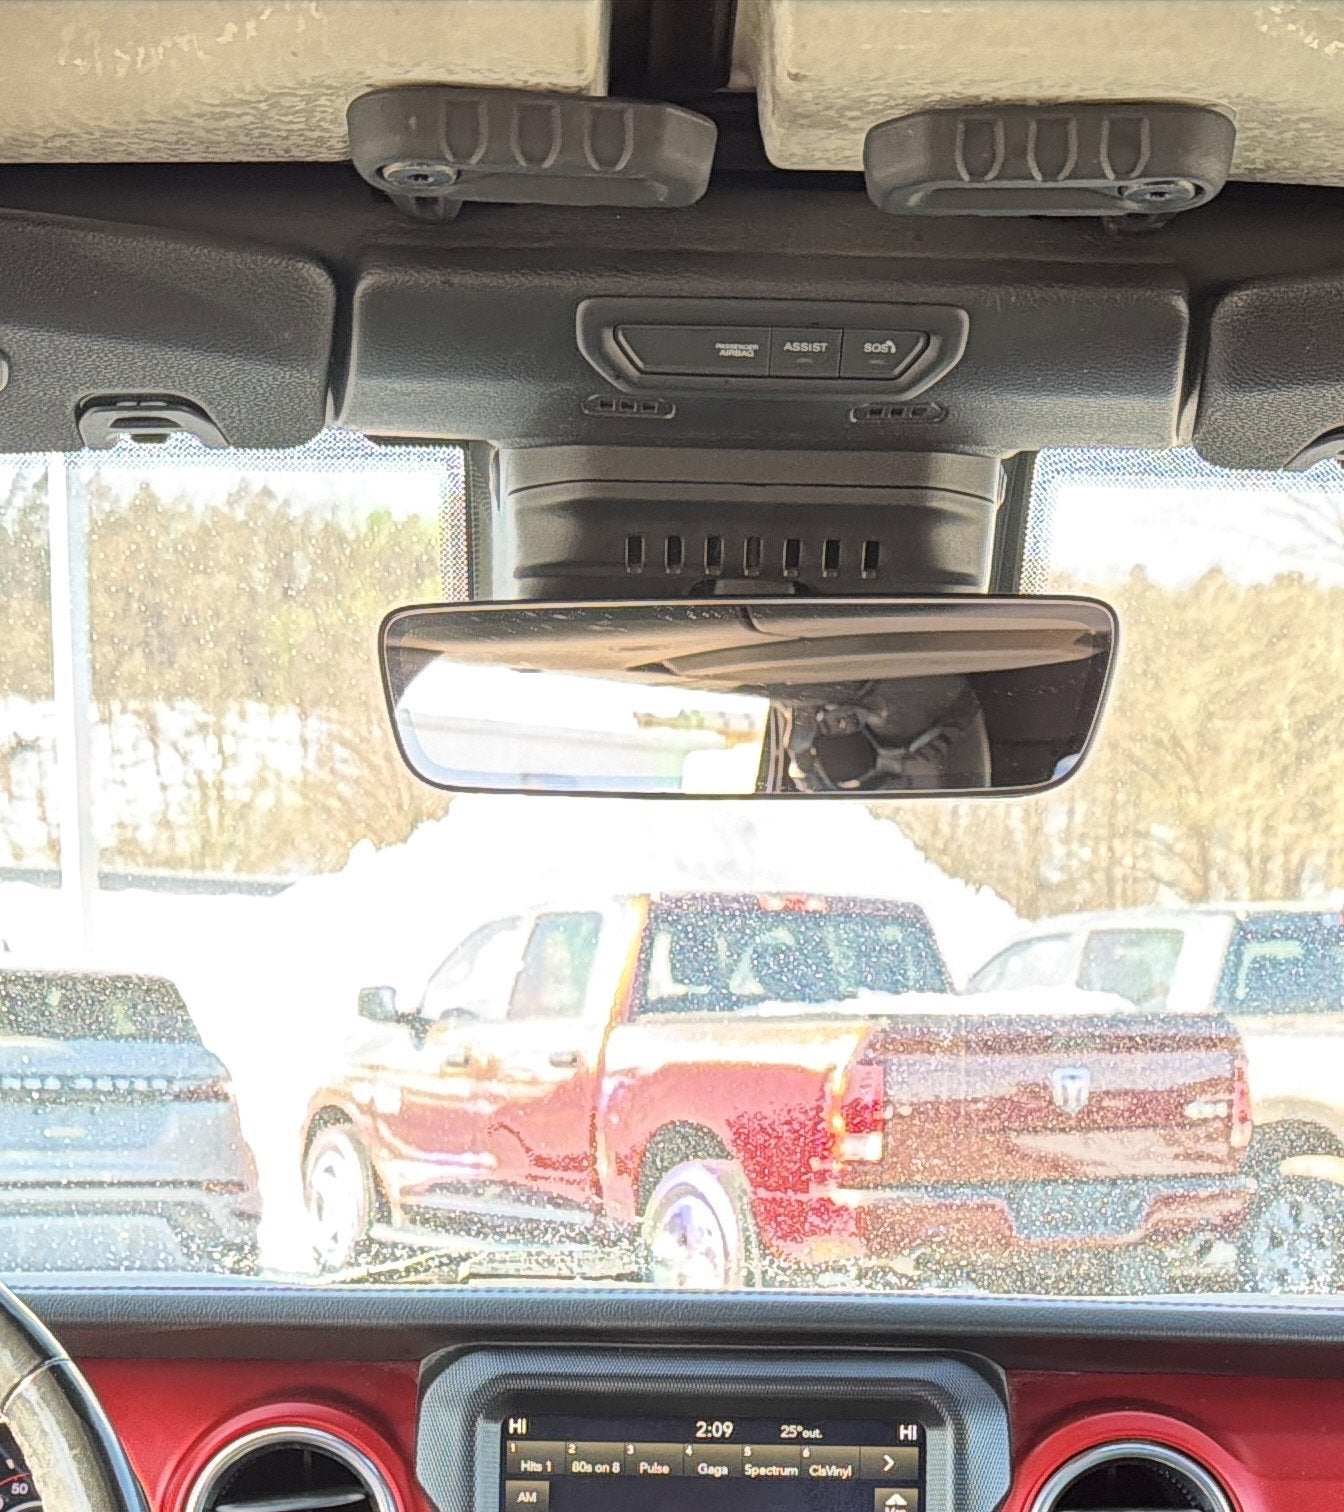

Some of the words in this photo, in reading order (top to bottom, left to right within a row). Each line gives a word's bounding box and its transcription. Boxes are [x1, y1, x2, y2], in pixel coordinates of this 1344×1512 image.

[784, 342, 829, 352] ASSIST
[864, 343, 887, 353] SOS
[719, 350, 755, 358] AIRBAG
[509, 1418, 528, 1435] HI
[695, 1421, 734, 1438] 2:09
[899, 1424, 918, 1441] HI
[567, 1443, 577, 1454] 2
[626, 1444, 635, 1455] 3
[684, 1444, 694, 1457] 4
[520, 1460, 543, 1472] Hits
[594, 1464, 610, 1473] on
[611, 1462, 621, 1473] 8
[639, 1462, 670, 1475] Pulse
[697, 1463, 729, 1478] Gaga
[744, 1464, 799, 1478] Spectrum
[10, 1482, 29, 1495] 50
[517, 1491, 537, 1504] AM
